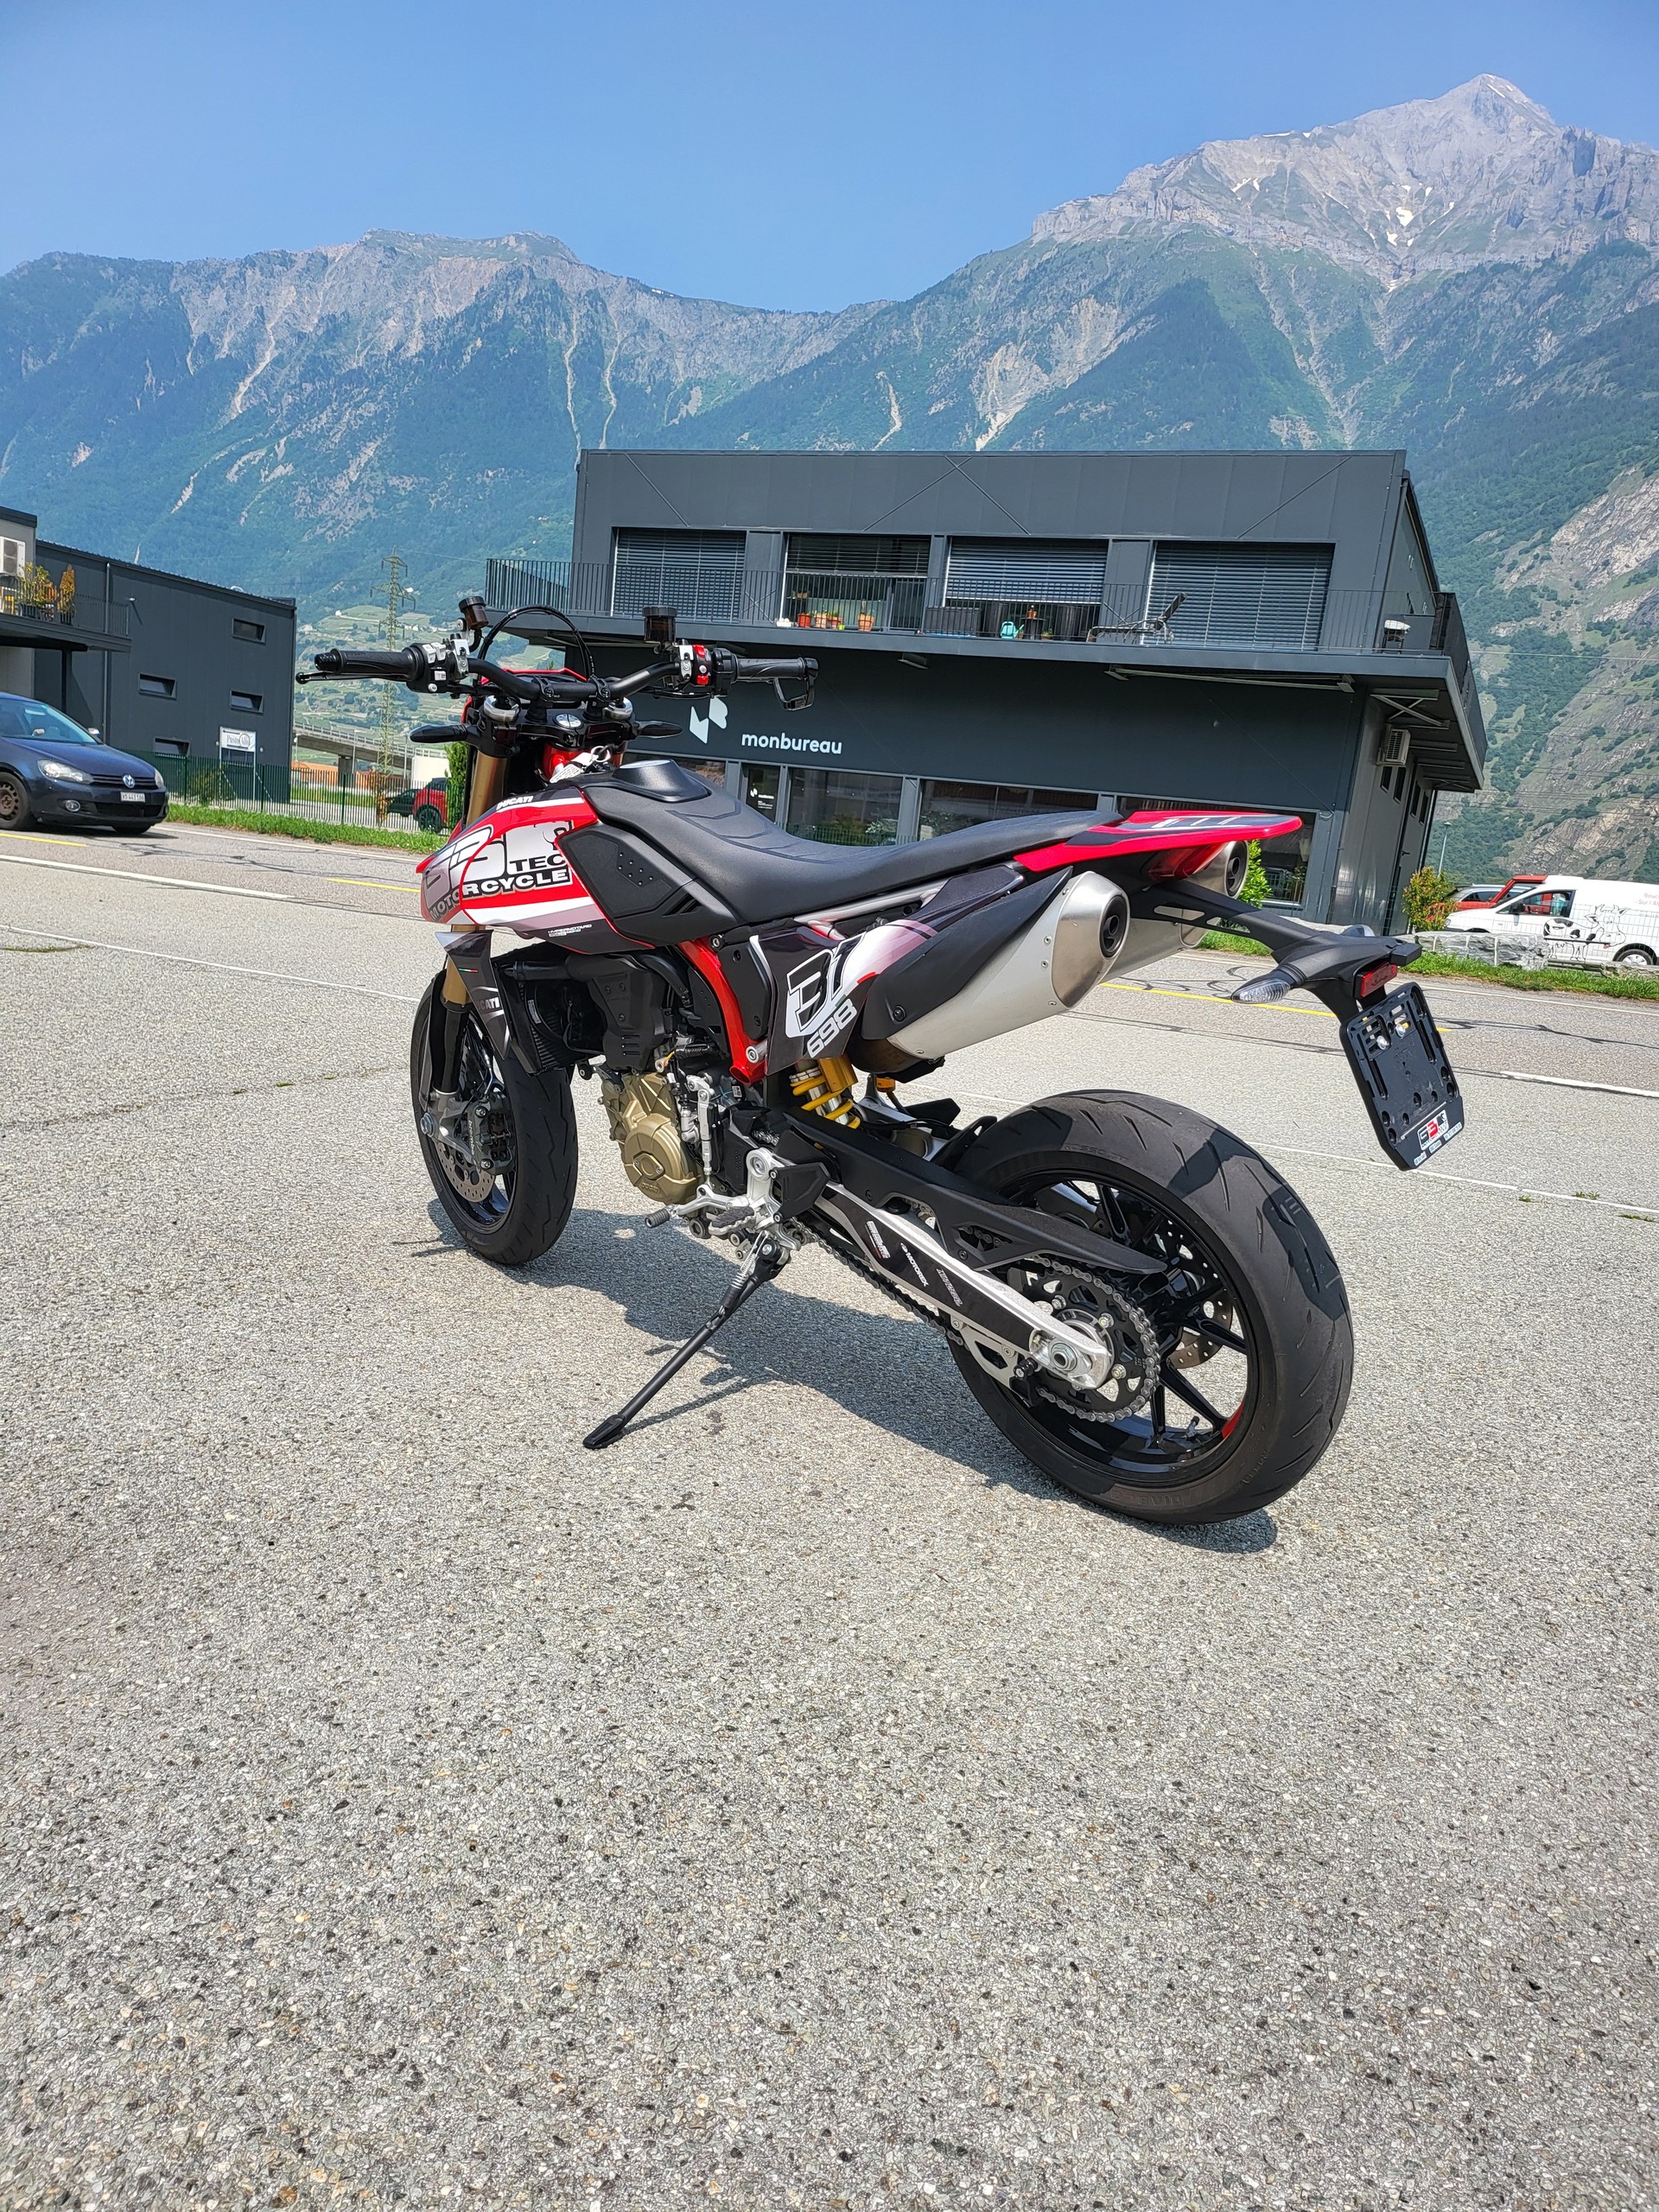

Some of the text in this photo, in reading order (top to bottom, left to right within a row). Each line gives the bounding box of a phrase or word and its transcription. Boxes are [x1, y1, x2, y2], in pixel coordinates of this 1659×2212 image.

[741, 732, 843, 755] monbureau
[495, 795, 534, 810] DUCATI
[429, 868, 569, 921] MOTORCYCLE
[806, 998, 858, 1058] 698
[906, 1252, 930, 1287] MOTOREX
